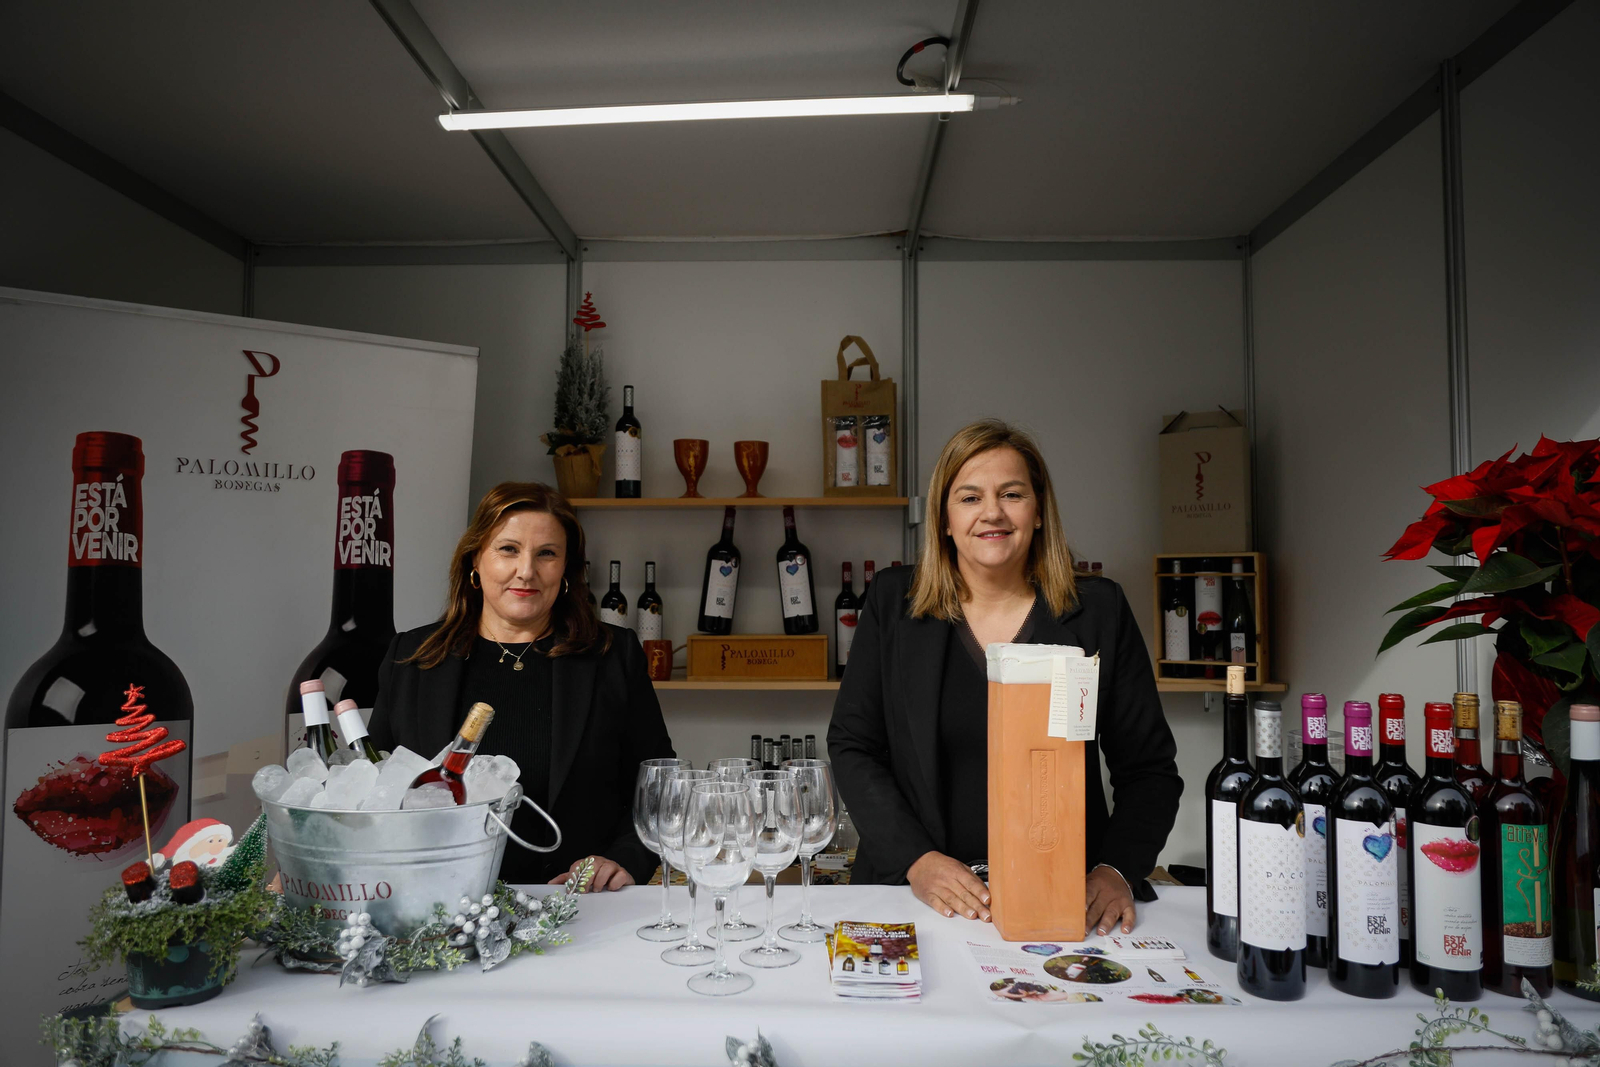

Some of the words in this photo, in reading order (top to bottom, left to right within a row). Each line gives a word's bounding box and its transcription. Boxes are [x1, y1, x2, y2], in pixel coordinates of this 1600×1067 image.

[176, 457, 316, 481] PALOMILLO
[75, 473, 128, 508] ESTÁ
[214, 479, 281, 493] BODEGAS
[341, 488, 383, 520] ESTÁ
[1171, 502, 1231, 514] PALOMILLO
[73, 507, 119, 533] POR
[339, 517, 377, 541] POR
[72, 531, 138, 562] VENIR
[338, 539, 392, 567] VENIR
[730, 648, 795, 659] PALOMILLO
[1352, 734, 1371, 742] POR
[1431, 727, 1453, 738] ESTÁ
[1432, 736, 1452, 745] POR
[1266, 871, 1304, 880] PACO
[283, 872, 393, 902] PALOMILLO
[1367, 913, 1387, 923] ESTÁ
[1367, 921, 1386, 929] POR
[1367, 927, 1391, 935] VENIR
[1444, 934, 1467, 944] ESTÁ
[1444, 941, 1465, 949] POR
[1444, 948, 1472, 957] VENIR
[59, 978, 96, 996] cobra
